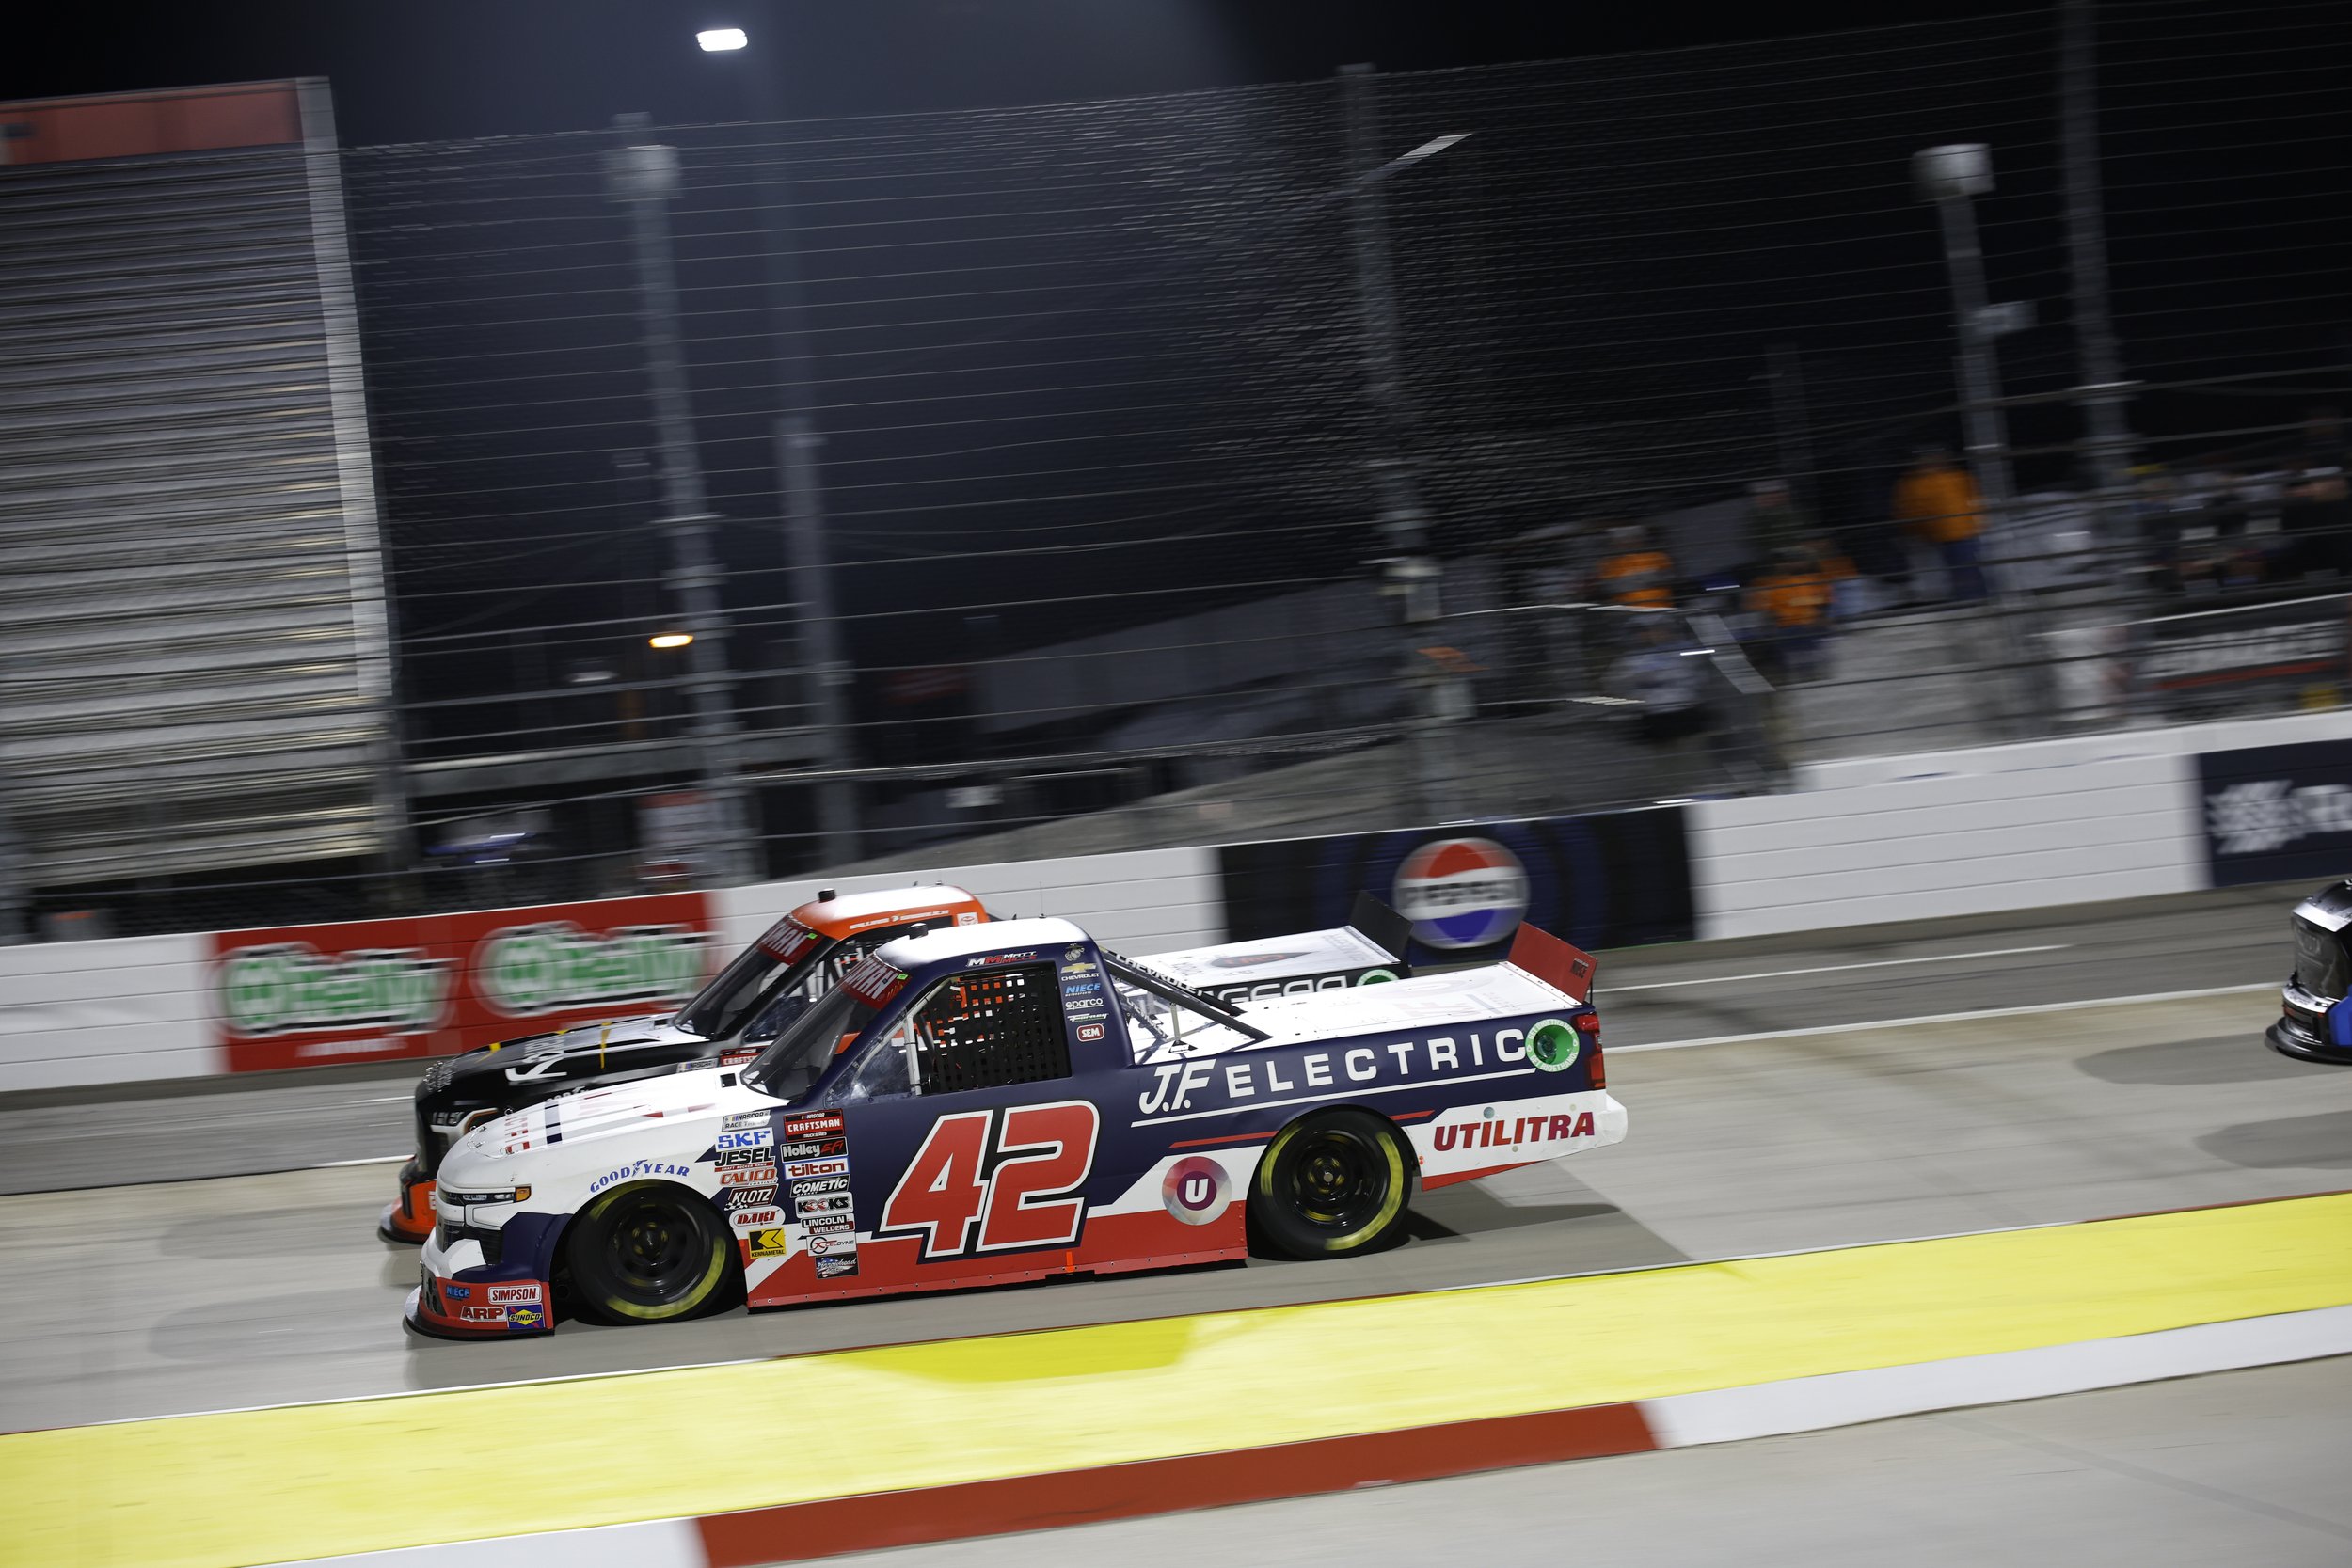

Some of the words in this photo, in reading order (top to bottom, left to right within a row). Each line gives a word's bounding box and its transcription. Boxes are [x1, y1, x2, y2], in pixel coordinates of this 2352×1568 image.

[1061, 973, 1100, 982] CHEVROLET
[1065, 982, 1102, 994] NIECE
[1065, 997, 1104, 1011] sparco
[1081, 1027, 1101, 1038] SEM
[1138, 1058, 1216, 1115] J.F.
[1225, 1028, 1526, 1099] ELECTRIC
[737, 1110, 765, 1121] NASCAR
[724, 1121, 743, 1130] RACE
[787, 1118, 841, 1132] CRAFTSMAN
[1433, 1111, 1596, 1152] UTILITRA
[718, 1130, 771, 1149] SKF
[714, 1148, 772, 1167] JESEL
[783, 1143, 821, 1158] Holley
[721, 1168, 776, 1185] CALICO
[788, 1161, 845, 1177] tilton
[792, 1178, 848, 1194] COMETIC
[879, 1099, 1101, 1259] 42
[732, 1188, 771, 1204] KLOTZ
[1185, 1178, 1209, 1203] U
[798, 1196, 850, 1213] KOOKS
[803, 1215, 845, 1228] LINCOLN
[813, 1224, 850, 1234] WELDERS
[751, 1248, 786, 1258] KENNAMETAL
[446, 1285, 470, 1299] NIECE
[492, 1287, 537, 1302] SIMPSON
[461, 1306, 505, 1321] ARP
[509, 1312, 542, 1323] SUNOCO
